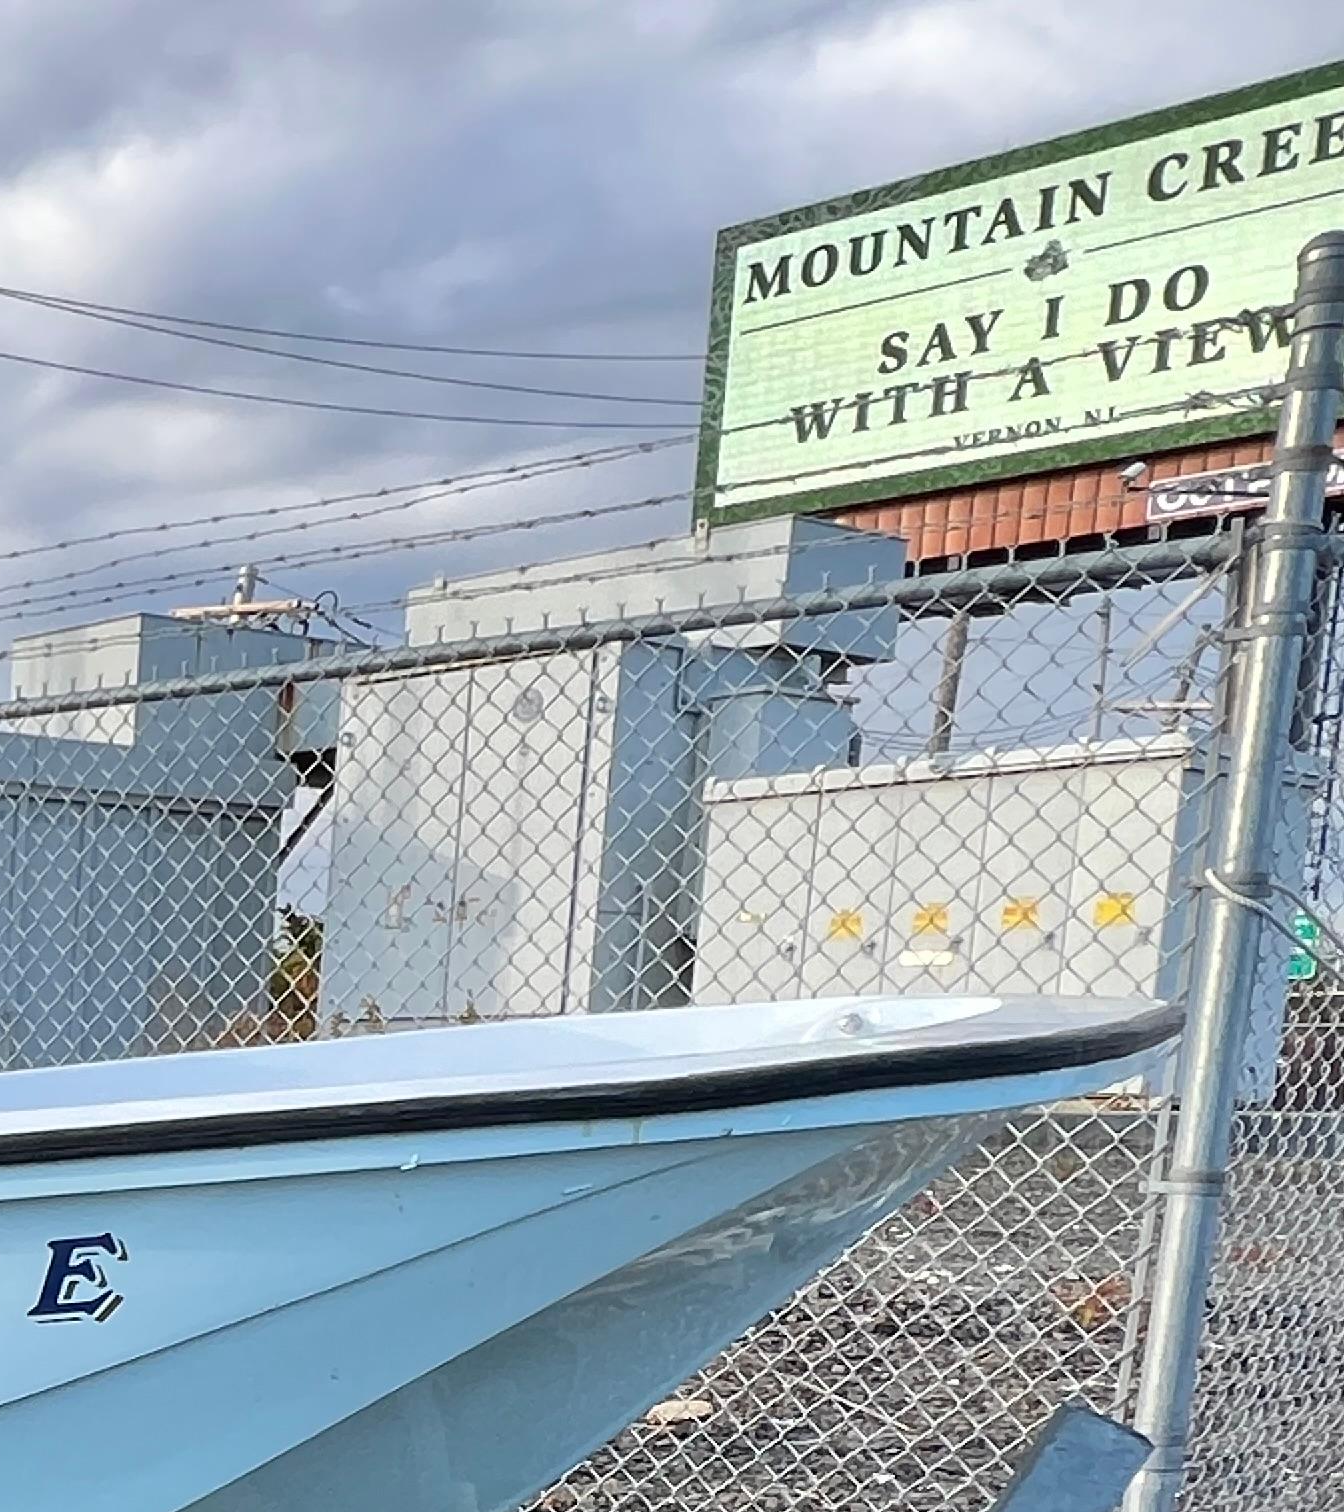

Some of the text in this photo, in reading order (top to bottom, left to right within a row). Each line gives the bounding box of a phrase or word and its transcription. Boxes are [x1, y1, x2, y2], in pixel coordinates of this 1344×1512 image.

[742, 173, 1112, 305] MOUNTAIN
[789, 309, 1293, 444] WITH A VIEW
[877, 263, 1211, 375] SAY I DO
[28, 1232, 129, 1324] E
